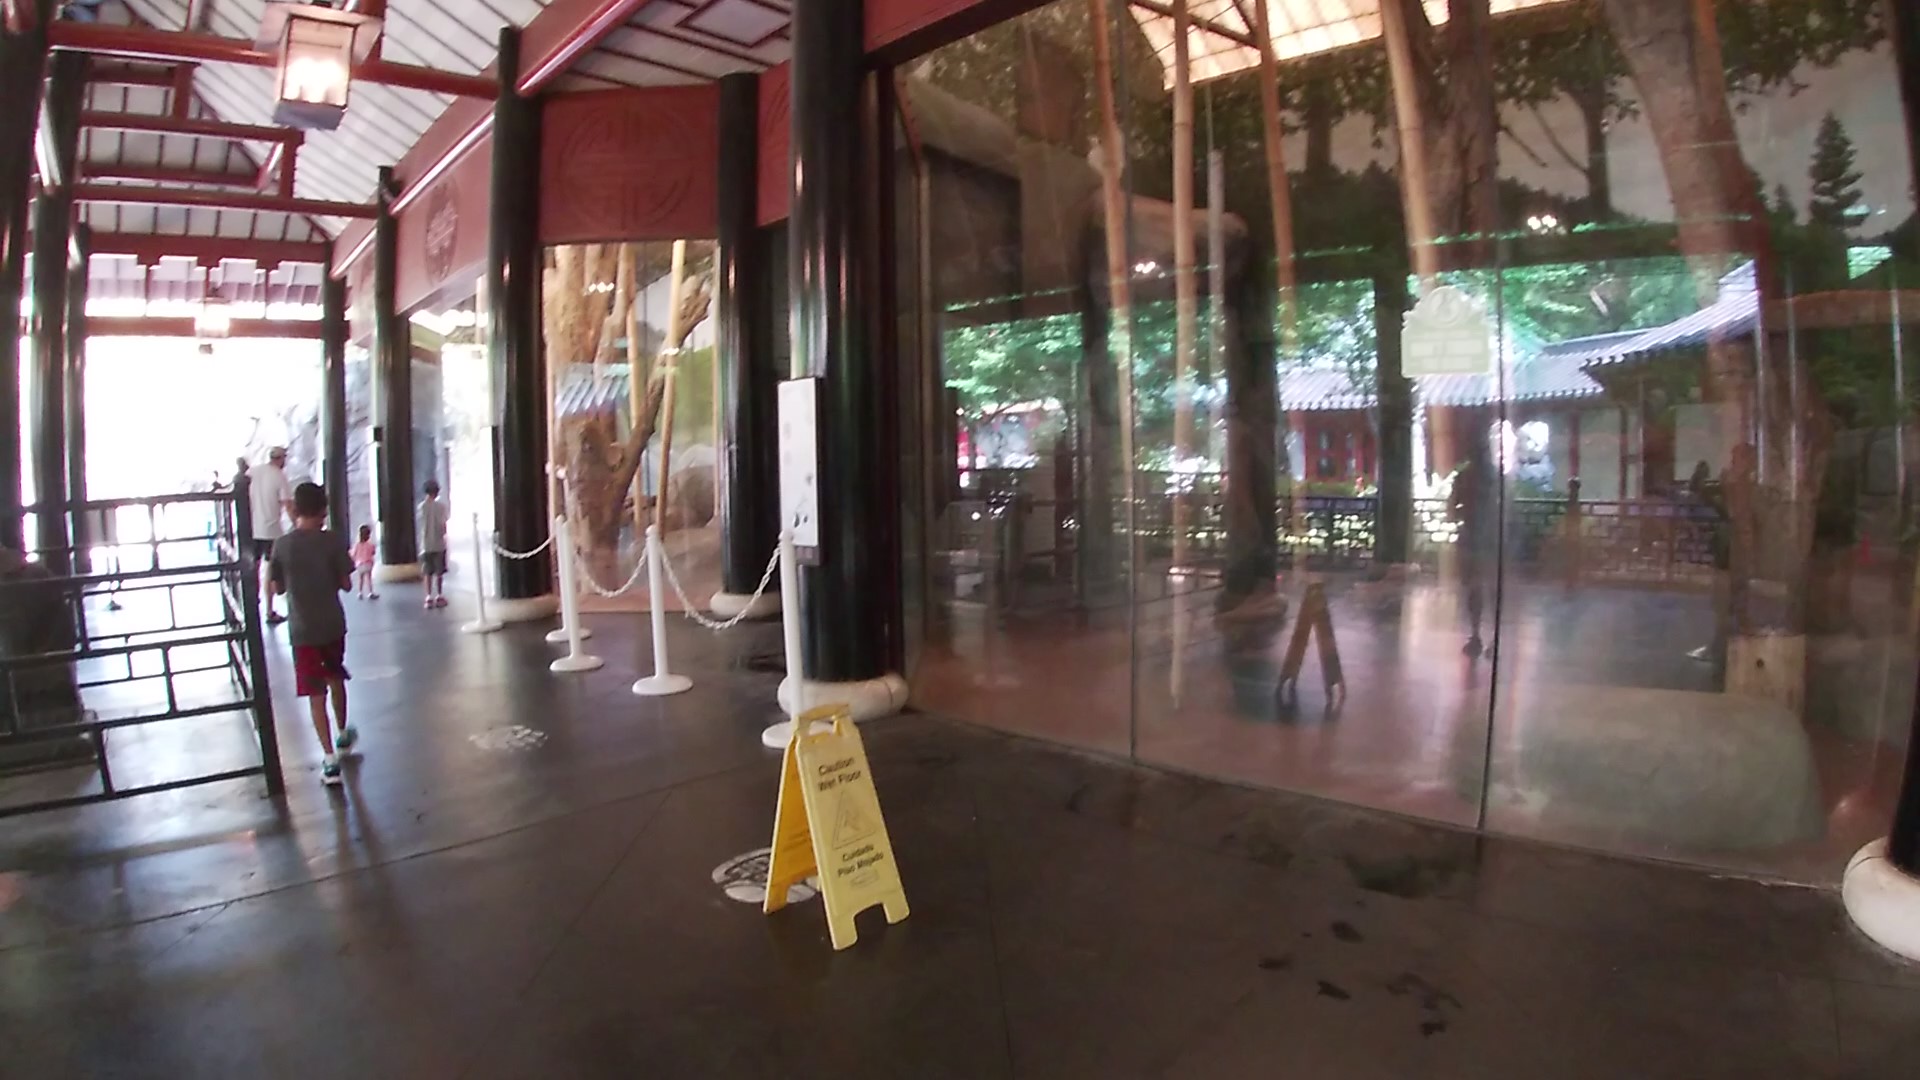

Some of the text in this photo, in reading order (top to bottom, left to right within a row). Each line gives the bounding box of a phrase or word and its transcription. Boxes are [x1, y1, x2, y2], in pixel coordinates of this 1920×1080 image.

[818, 757, 855, 776] Caution
[818, 770, 862, 791] Wet Floor
[842, 844, 874, 862] Cuidado
[837, 865, 856, 878] Piso
[857, 851, 884, 870] Mojado
